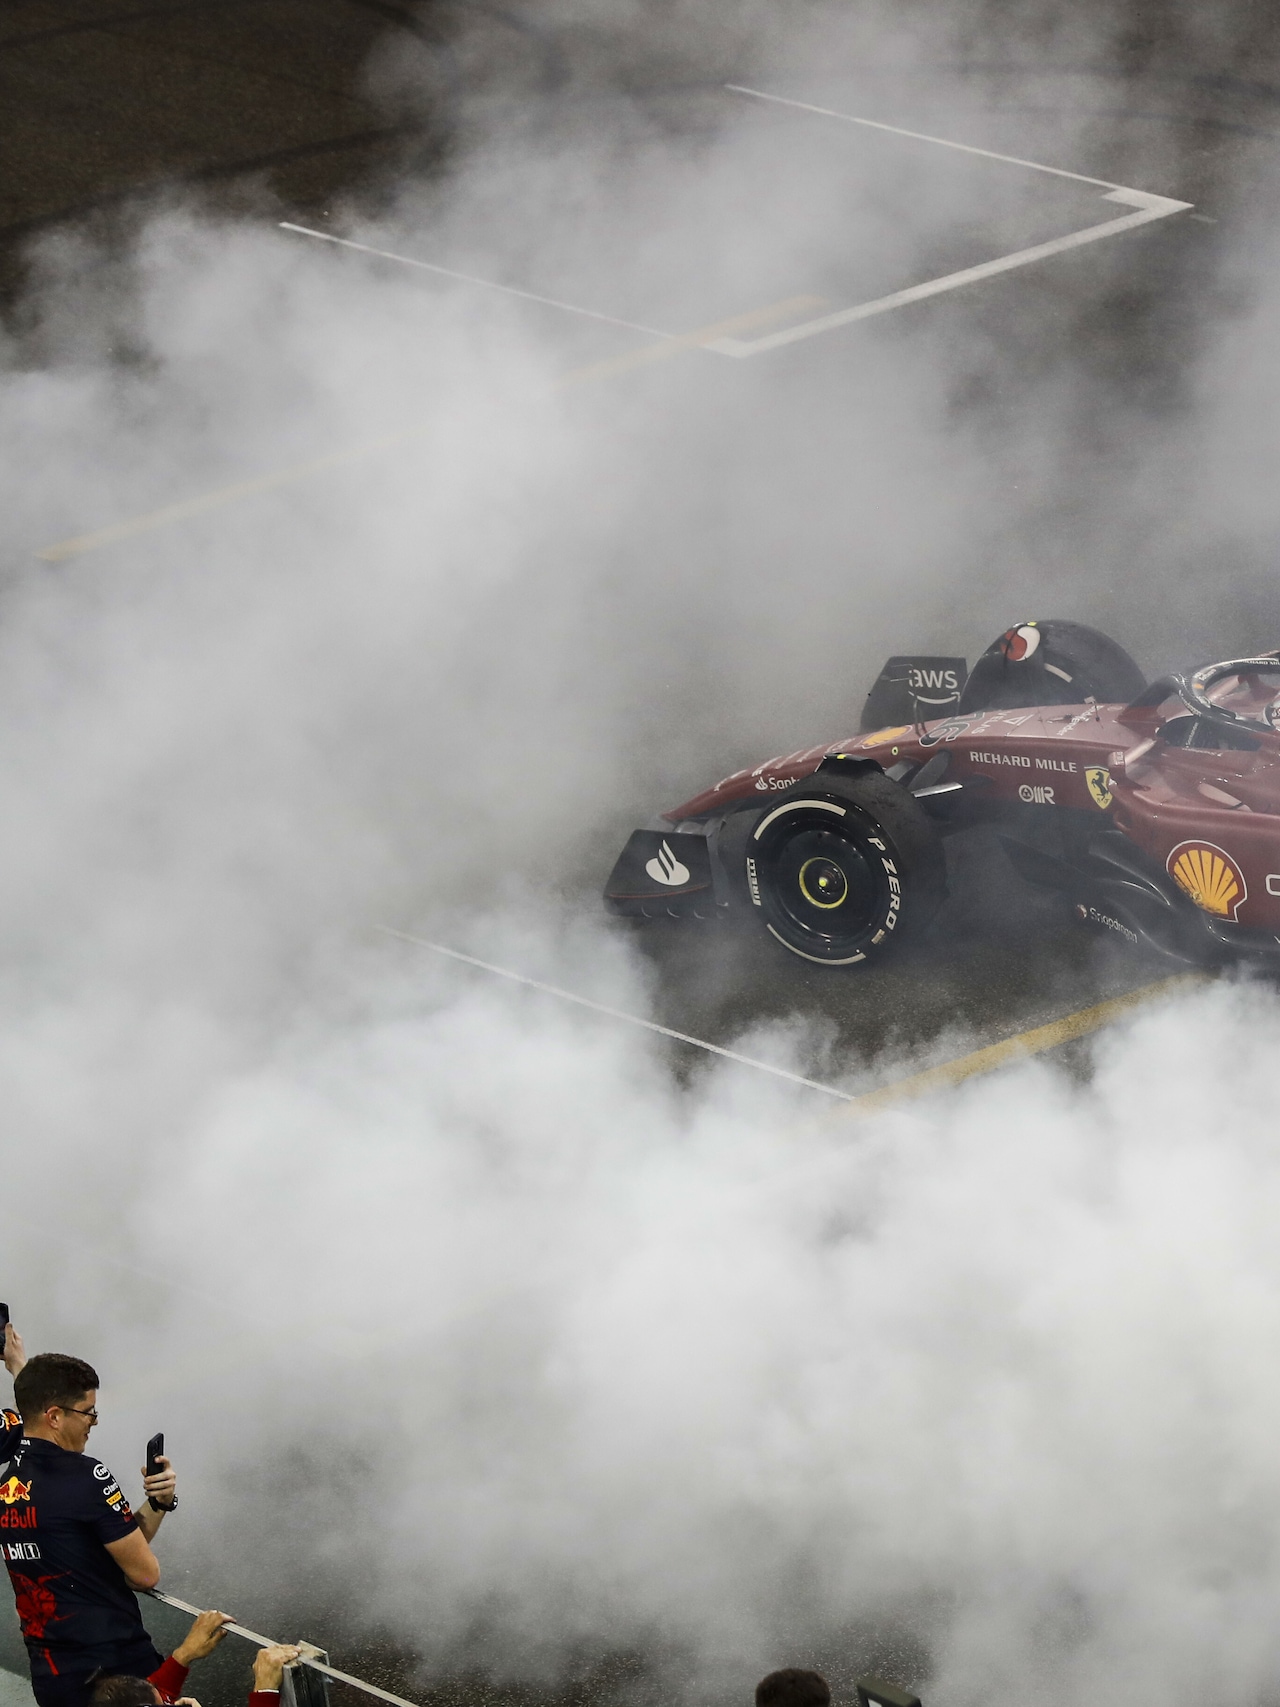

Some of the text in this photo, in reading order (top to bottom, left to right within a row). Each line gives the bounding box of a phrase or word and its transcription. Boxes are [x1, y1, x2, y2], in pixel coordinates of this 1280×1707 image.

[970, 751, 1078, 773] RICHARD MILLE
[867, 837, 901, 931] P ZERO
[10, 1507, 37, 1528] Bull
